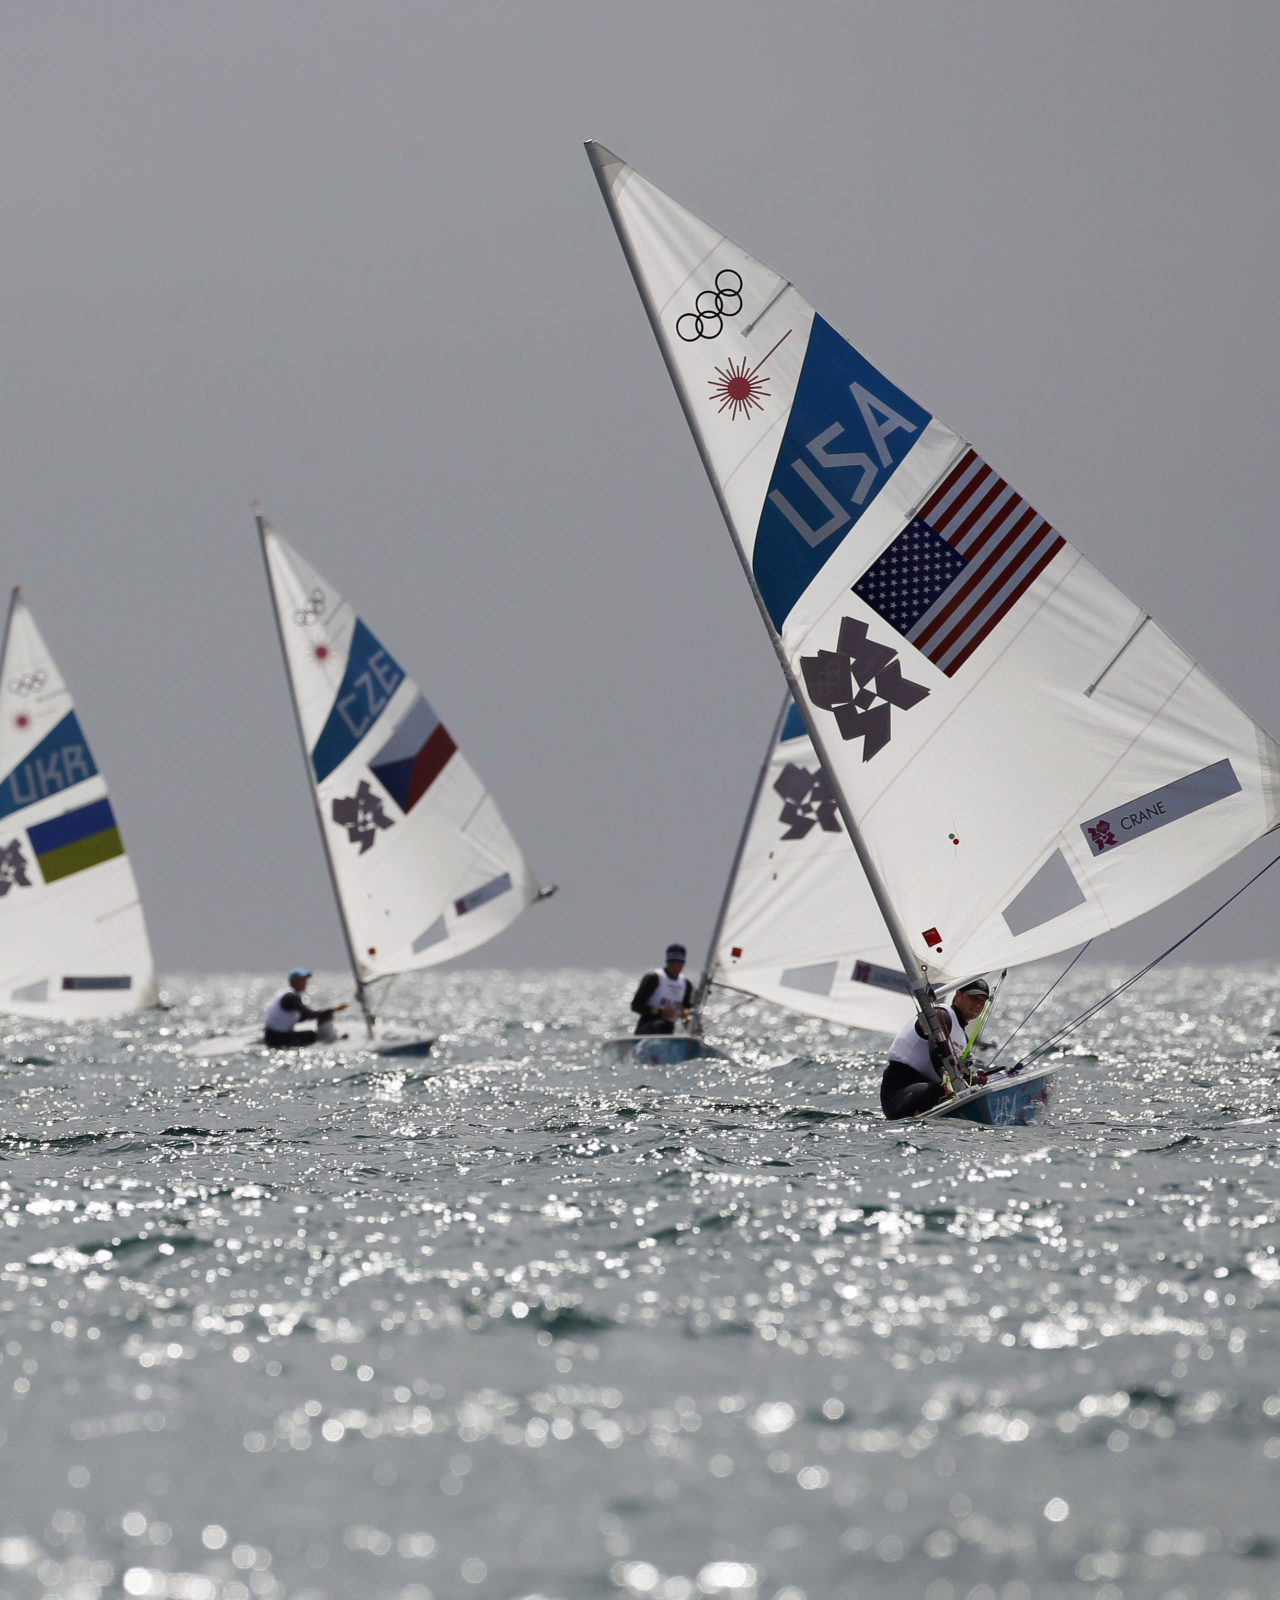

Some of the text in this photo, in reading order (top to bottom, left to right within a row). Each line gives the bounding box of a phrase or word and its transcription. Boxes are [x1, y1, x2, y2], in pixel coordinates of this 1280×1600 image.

[768, 381, 918, 549] USA
[334, 649, 400, 739] CZE
[8, 744, 90, 804] UKR
[1120, 801, 1167, 830] CRANE
